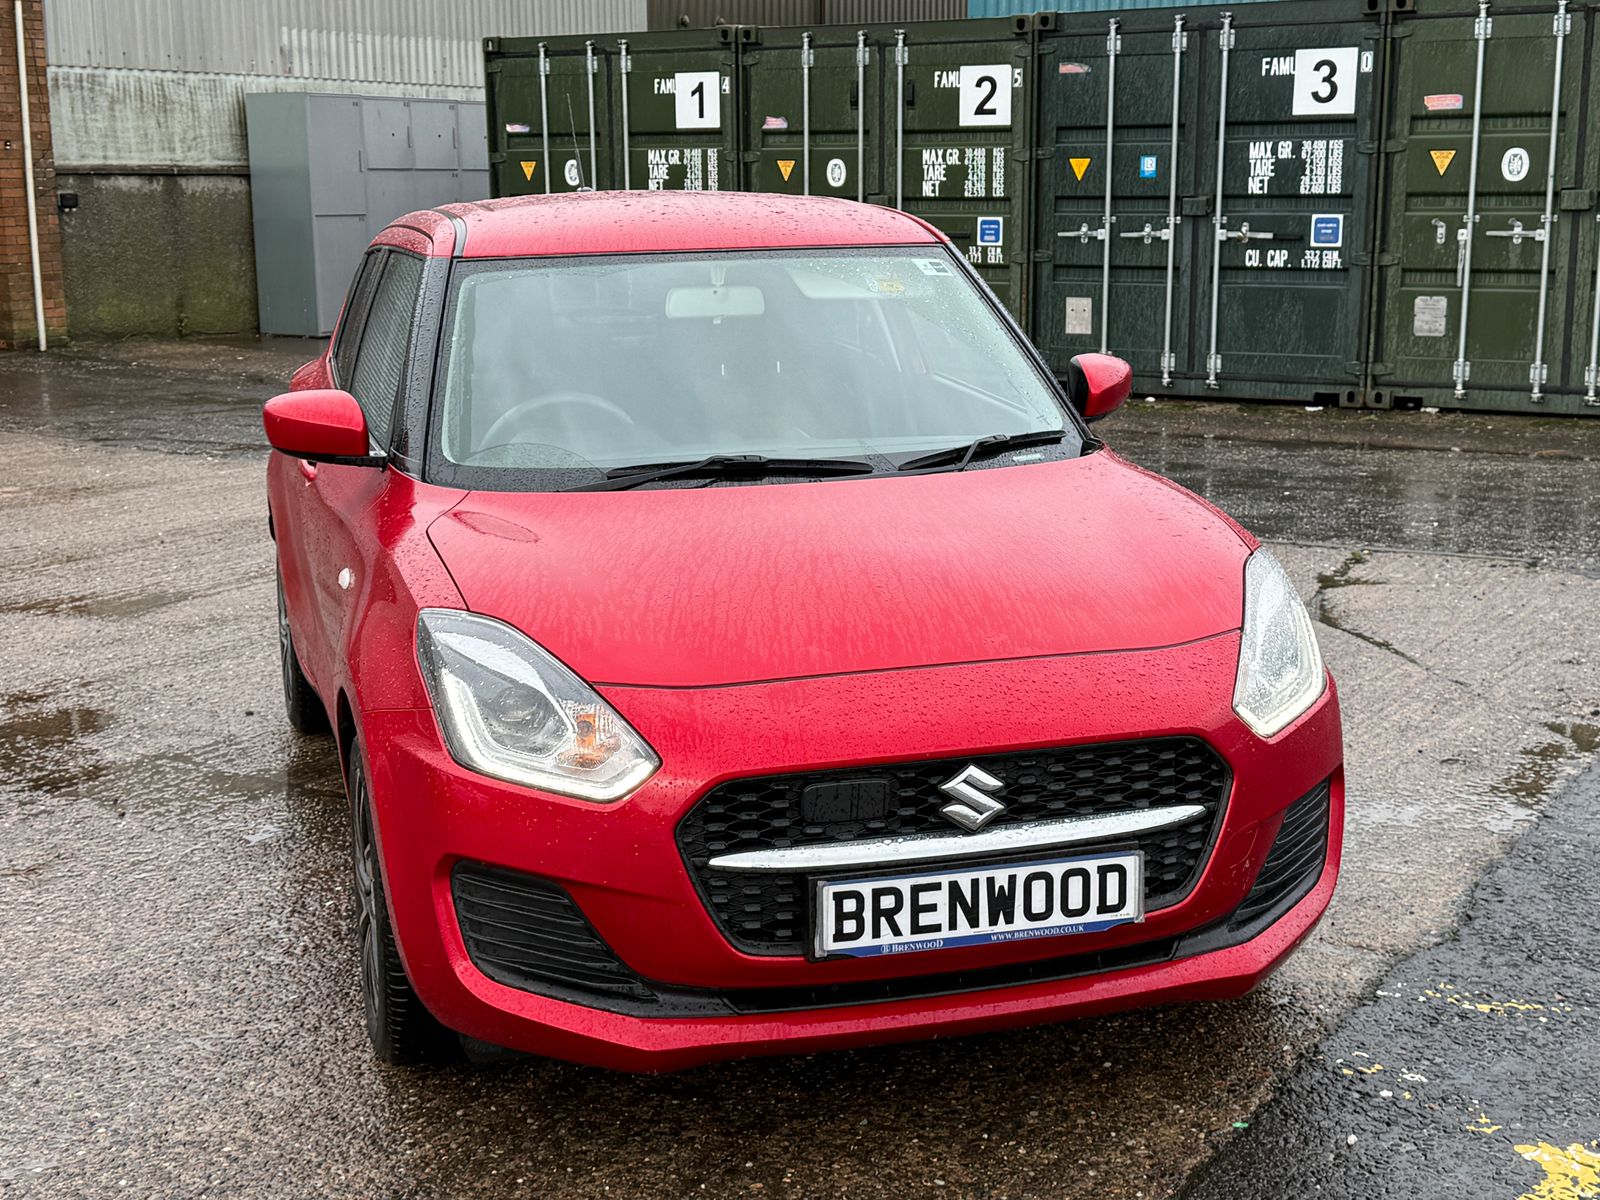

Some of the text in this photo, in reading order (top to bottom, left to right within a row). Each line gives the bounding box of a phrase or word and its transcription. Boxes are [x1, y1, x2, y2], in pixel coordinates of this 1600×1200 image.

[721, 77, 730, 93] 4
[1013, 69, 1022, 87] 5
[1311, 59, 1338, 103] 3
[691, 81, 704, 118] 1
[974, 76, 997, 115] 2
[1278, 141, 1296, 159] GR.
[648, 164, 669, 179] TARE
[922, 165, 947, 181] TARE
[1249, 159, 1275, 176] TARE
[648, 179, 664, 191] NET
[922, 181, 940, 197] NET
[1248, 176, 1269, 194] NET
[1245, 249, 1292, 268] CU. CAP.
[832, 864, 1128, 943] BRENWOOD
[990, 924, 1085, 941] WWW.BRENWOOD.CO.UK
[891, 939, 943, 953] BRENWOOD
